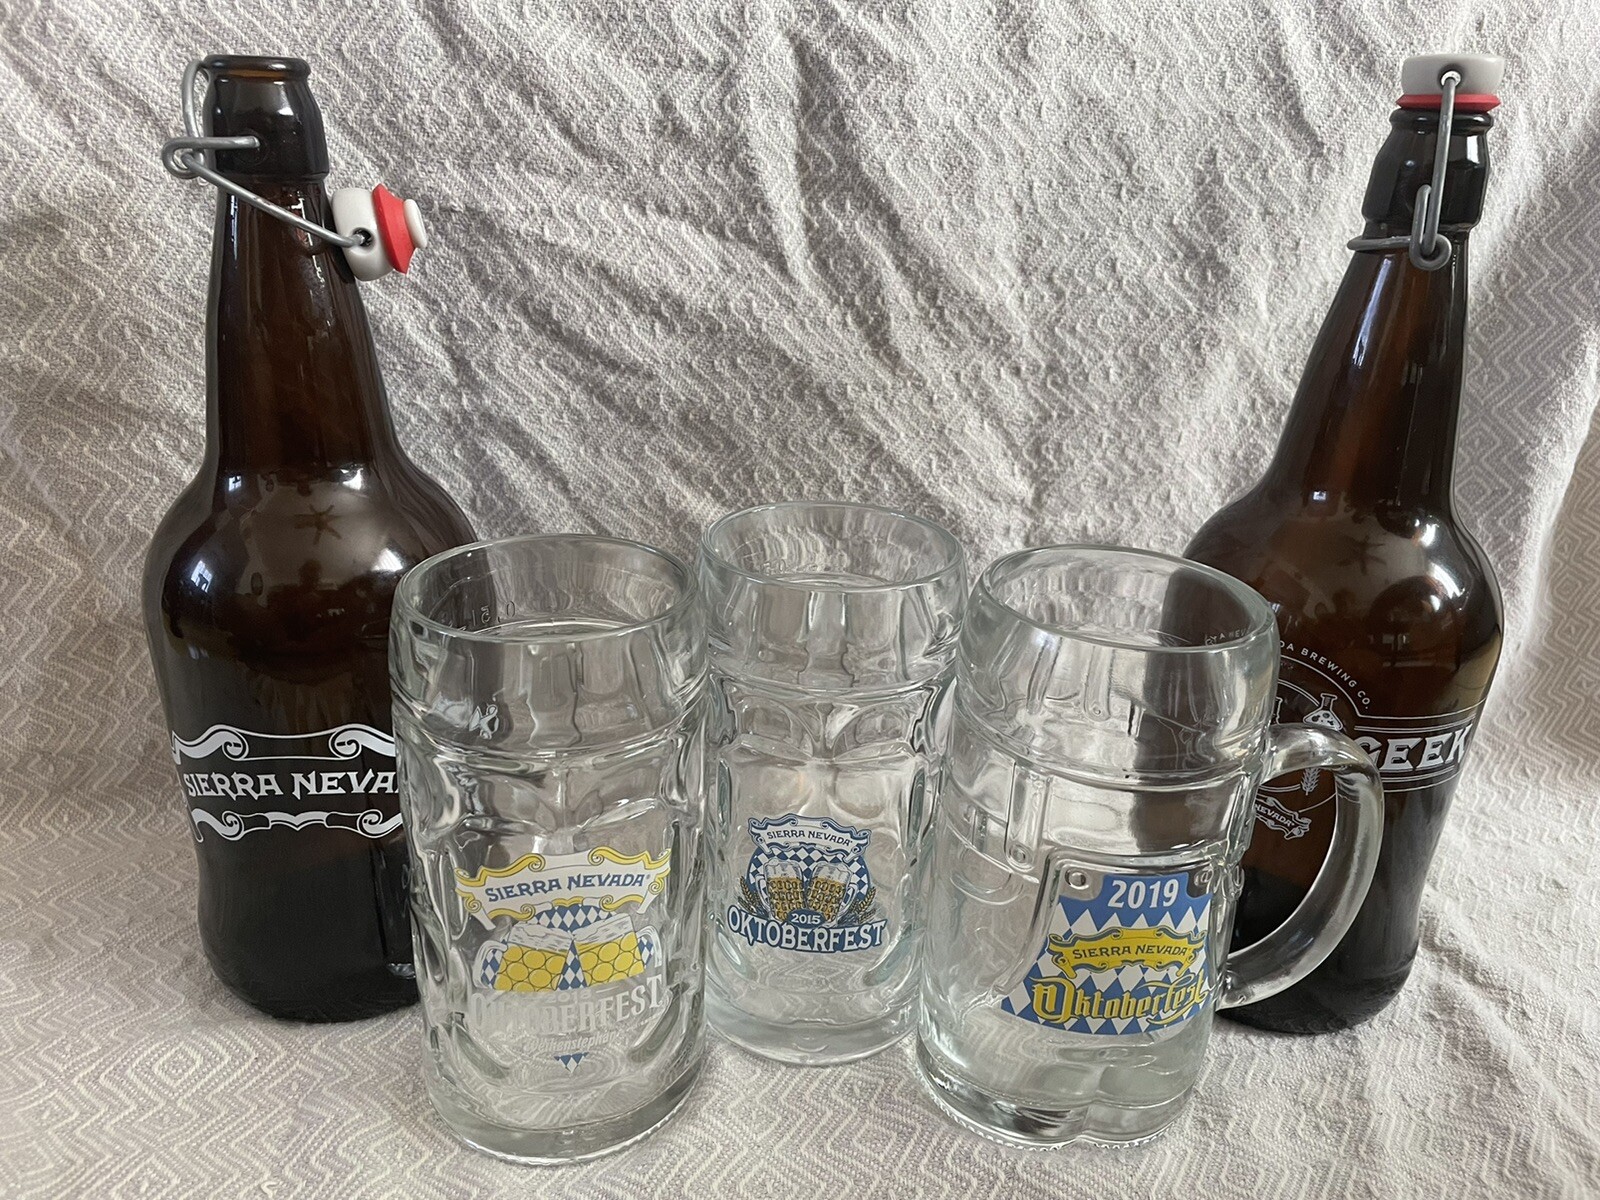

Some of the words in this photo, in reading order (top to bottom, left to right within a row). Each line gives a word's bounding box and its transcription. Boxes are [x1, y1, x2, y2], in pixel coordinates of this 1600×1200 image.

[1300, 647, 1357, 688] BREWING
[1357, 690, 1371, 710] CO.
[183, 772, 283, 800] SIERRA
[291, 768, 399, 800] NEVA
[766, 829, 806, 840] SIERRA
[808, 830, 851, 847] NEVADA
[485, 879, 561, 902] SIERRA
[567, 873, 645, 890] NEVADA
[1107, 878, 1180, 910] 2019
[728, 906, 886, 952] OKTOBERFEST
[790, 912, 821, 925] 2015
[1072, 946, 1132, 960] SIERRA
[1135, 943, 1187, 957] NEVADA
[1029, 970, 1209, 1025] Oktoberfest
